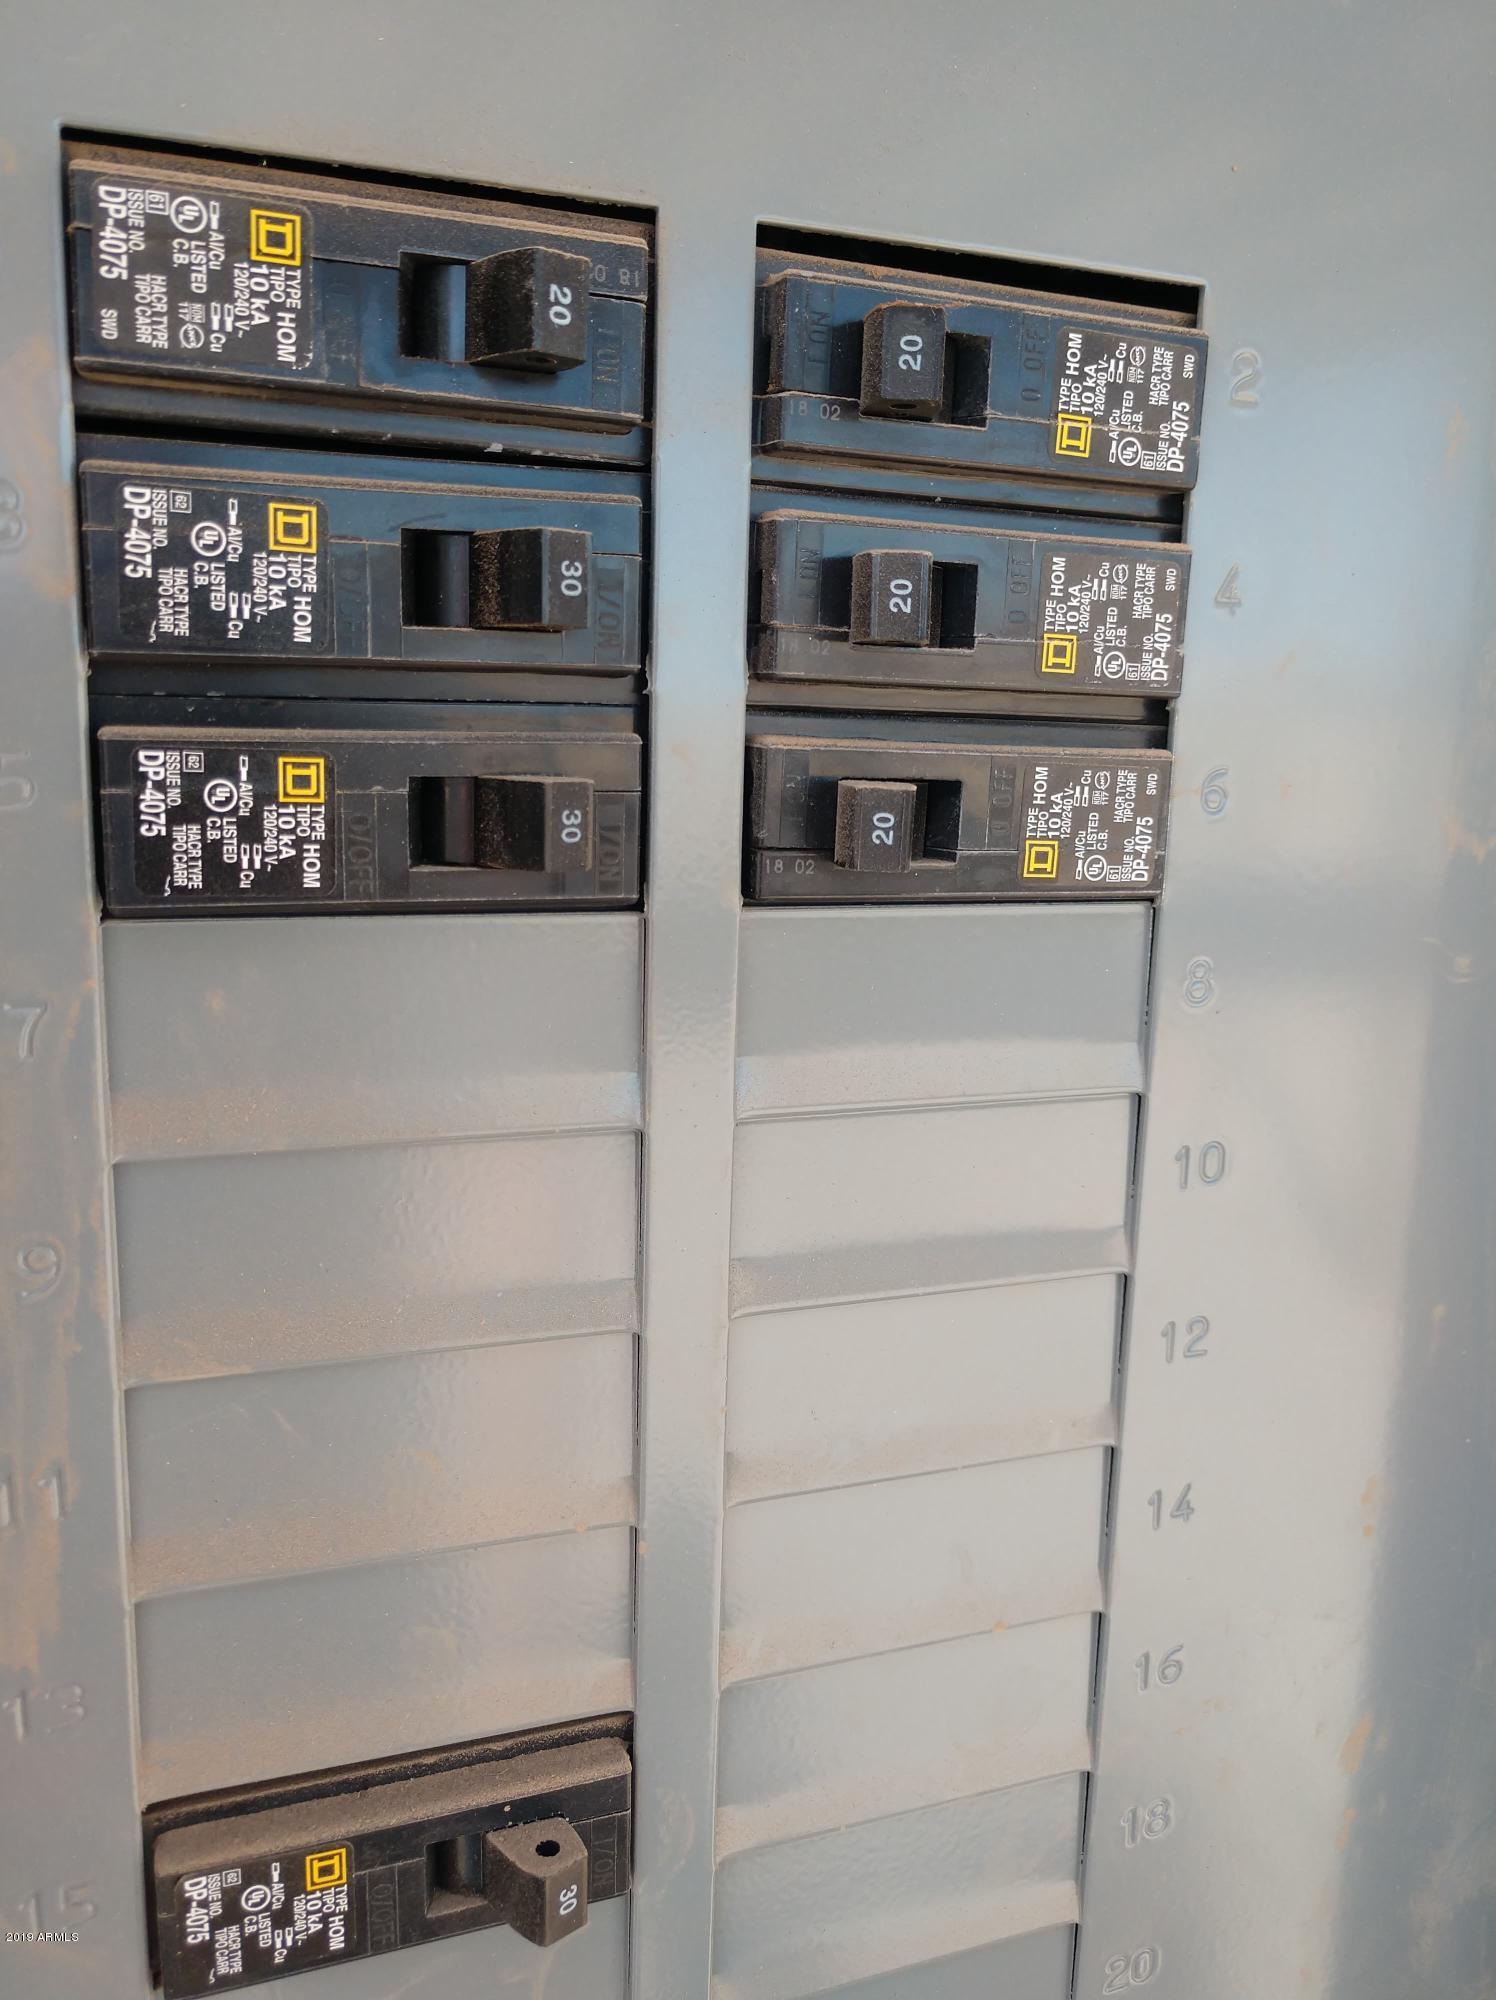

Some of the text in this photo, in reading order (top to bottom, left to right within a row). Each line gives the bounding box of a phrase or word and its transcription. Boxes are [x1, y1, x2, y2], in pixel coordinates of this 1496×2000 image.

[98, 185, 128, 280] DP-4075
[128, 188, 145, 253] ISSUE NO.
[172, 238, 189, 267] C.B.
[190, 240, 207, 294] LISTED
[234, 262, 249, 317] 120/240
[251, 265, 269, 325] 10 kA
[270, 267, 285, 302] TIPO
[549, 283, 573, 327] 20
[101, 308, 117, 340] SWD
[135, 274, 152, 344] TIPO CARR
[151, 275, 168, 349] HACR TYPE
[277, 269, 301, 362] TYPE HOM
[210, 333, 225, 352] Cu
[898, 335, 923, 372] 20
[1116, 343, 1127, 358] Cu
[1183, 354, 1195, 378] SWD
[1059, 333, 1082, 411] TYPE HOM
[1081, 364, 1098, 414] 10 kA
[1094, 371, 1107, 417] 120/240
[1149, 346, 1164, 405] HACR TYPE
[1159, 351, 1174, 406] TIPO CARR
[1230, 347, 1262, 409] 2
[820, 403, 840, 421] 02
[1069, 383, 1082, 413] TIPO
[1132, 411, 1143, 433] C.B.
[1156, 421, 1171, 470] ISSUE NO.
[1167, 401, 1189, 472] DP-4075
[123, 486, 152, 578] DP-4075
[152, 489, 168, 549] ISSUE NO.
[194, 562, 209, 588] C.B.
[210, 562, 226, 611] LISTED
[253, 552, 267, 602] 120/240
[269, 553, 287, 610] 10 kA
[287, 554, 301, 588] TIPO
[560, 560, 583, 597] 30
[1044, 557, 1066, 631] TYPE HOM
[1099, 563, 1109, 577] Cu
[1133, 563, 1147, 619] HACR TYPE
[1142, 566, 1156, 619] TIPO CARR
[1165, 569, 1176, 591] SWD
[1214, 560, 1242, 618] 4
[158, 567, 173, 632] TIPO CARR
[174, 568, 189, 636] HACR TYPE
[294, 556, 317, 642] TYPE HOM
[889, 579, 912, 614] 20
[1055, 604, 1066, 632] TIPO
[1066, 585, 1081, 633] 10 kA
[1079, 592, 1091, 633] 120/240
[228, 620, 243, 639] Cu
[1106, 607, 1118, 646] LISTED
[1116, 625, 1128, 647] C.B.
[1151, 613, 1173, 681] DP-4075
[1141, 633, 1153, 681] ISSUE NO.
[138, 750, 166, 836] DP-4075
[166, 752, 181, 808] ISSUE NO.
[1081, 770, 1092, 785] Cu
[1114, 770, 1128, 823] HACR TYPE
[1123, 773, 1138, 823] TIPO CARR
[1146, 774, 1158, 795] SWD
[1201, 765, 1229, 816] 6
[297, 805, 310, 837] TIPO
[1026, 767, 1048, 837] TYPE HOM
[1036, 811, 1049, 838] TIPO
[1047, 792, 1064, 838] 10 kA
[1060, 798, 1073, 839] 120/240
[206, 817, 221, 843] C.B.
[223, 817, 237, 863] LISTED
[264, 804, 277, 852] 120/240
[278, 805, 296, 859] 10 kA
[303, 805, 324, 887] TYPE HOM
[560, 809, 582, 844] 30
[872, 812, 895, 846] 20
[1087, 813, 1099, 850] LISTED
[1097, 829, 1109, 851] C.B.
[1131, 816, 1154, 882] DP-4075
[172, 824, 188, 886] TIPO CARR
[188, 825, 202, 889] HACR TYPE
[765, 858, 815, 875] 18 02
[1121, 836, 1134, 882] ISSUE NO.
[240, 871, 254, 888] Cu
[1184, 955, 1213, 1008] 8
[2, 1002, 48, 1062] 7
[1174, 1141, 1227, 1191] 10
[17, 1241, 64, 1305] 9
[1160, 1315, 1210, 1364] 12
[1147, 1482, 1195, 1530] 14
[1134, 1643, 1184, 1693] 16
[1121, 1798, 1172, 1849] 18
[184, 1876, 210, 1944] DP-4075
[208, 1873, 222, 1919] ISSUE NO.
[294, 1894, 307, 1931] 120/240
[307, 1891, 323, 1934] 10 kA
[323, 1887, 335, 1912] TIPO
[329, 1885, 348, 1950] TYPE HOM
[559, 1884, 578, 1916] 30
[228, 1925, 242, 1974] HACR TYPE
[244, 1916, 257, 1937] C.B.
[258, 1912, 271, 1947] LISTED
[215, 1928, 229, 1975] TIPO CARR
[274, 1949, 287, 1963] Cu
[1102, 1946, 1162, 1996] 20
